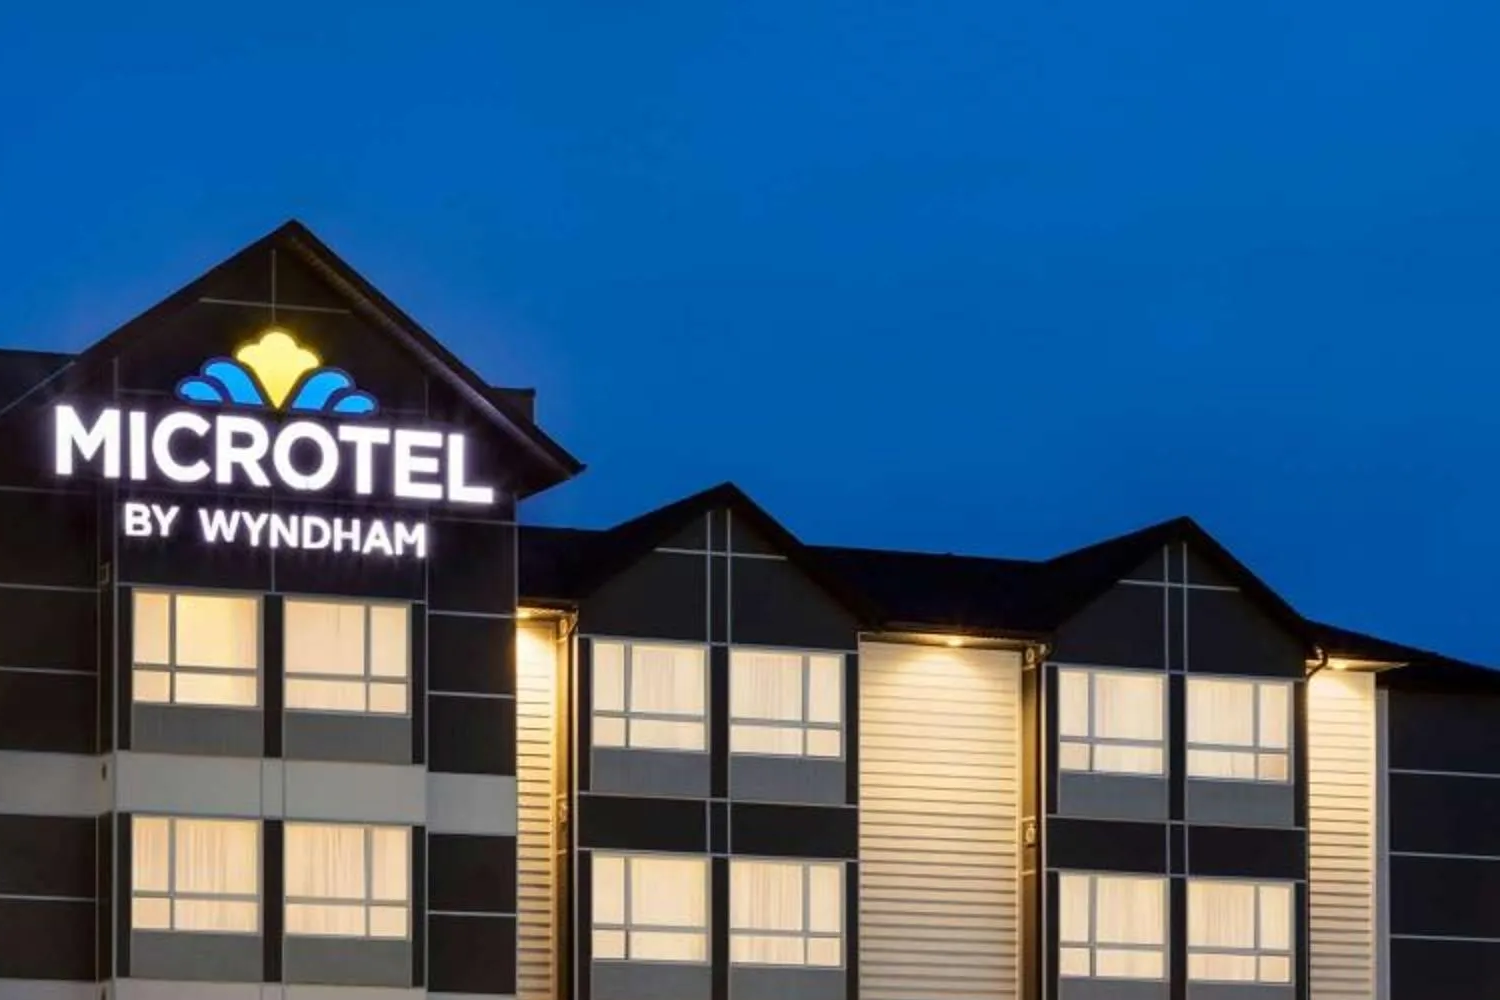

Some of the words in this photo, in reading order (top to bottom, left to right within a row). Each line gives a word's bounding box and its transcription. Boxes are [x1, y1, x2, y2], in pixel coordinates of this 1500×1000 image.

[54, 404, 494, 504] MICROTEL
[124, 503, 180, 537] BY
[198, 508, 427, 558] WYNDHAM
